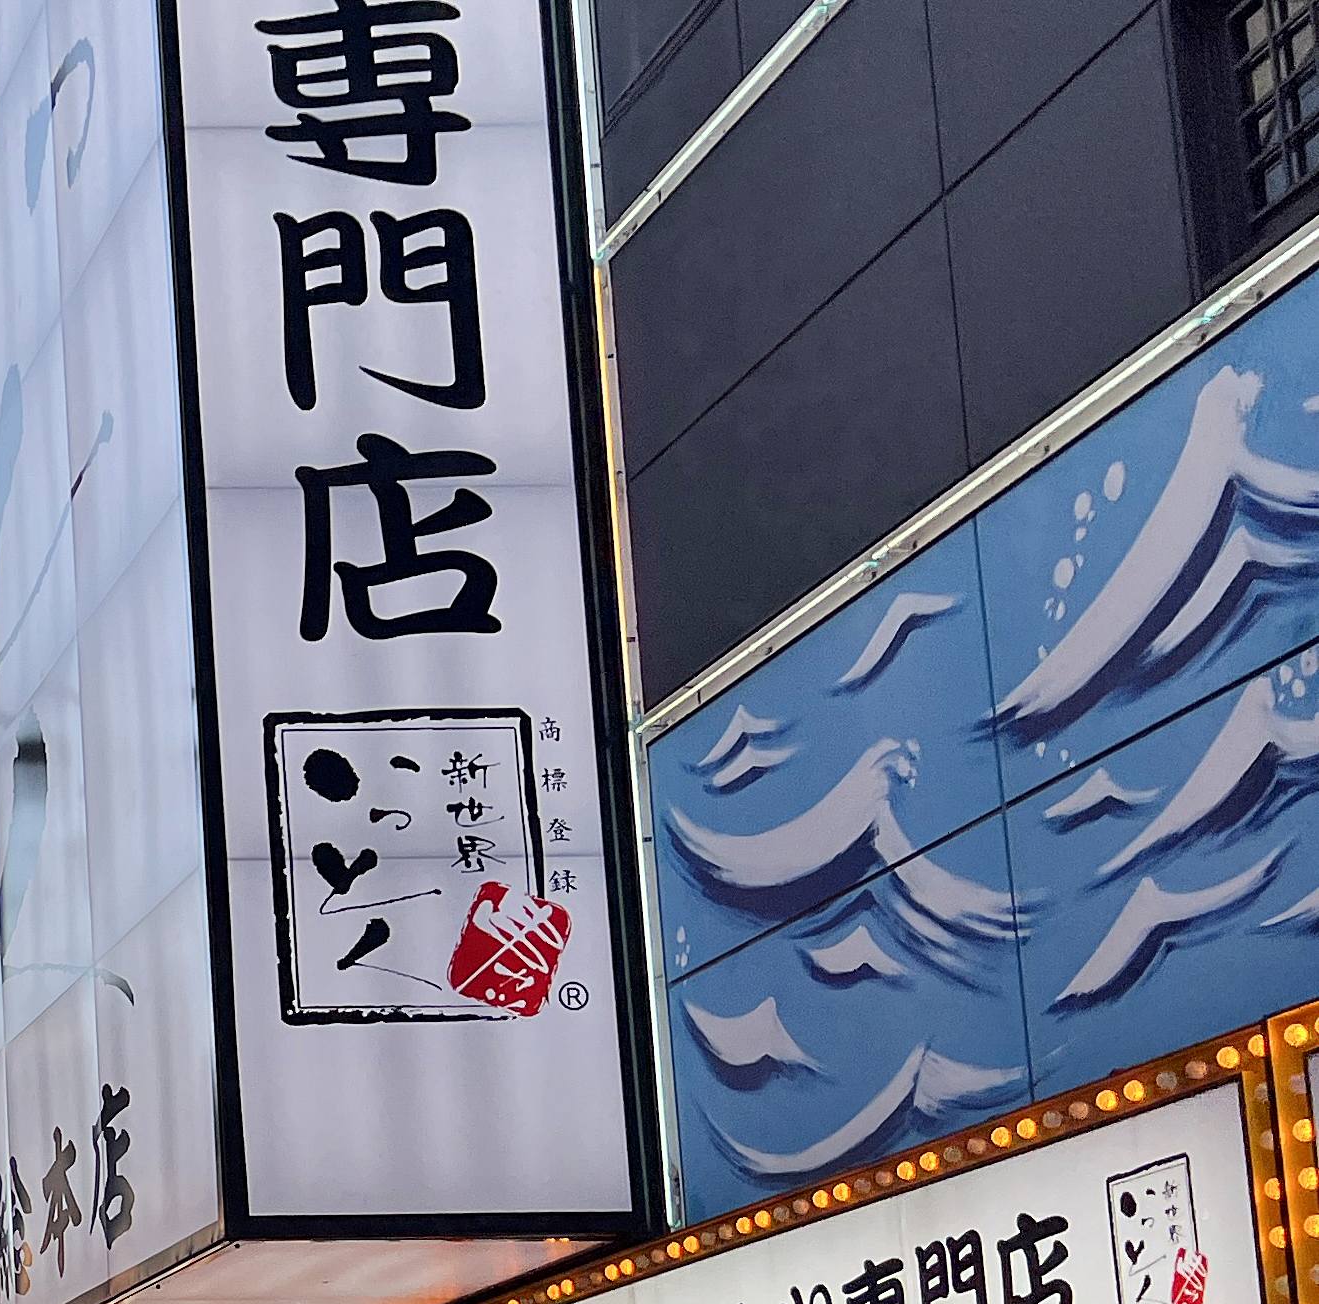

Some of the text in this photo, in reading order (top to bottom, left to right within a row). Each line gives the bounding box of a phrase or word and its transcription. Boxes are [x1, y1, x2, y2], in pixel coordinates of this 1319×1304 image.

[442, 752, 507, 873] 新世界
[539, 717, 578, 893] 商標登録
